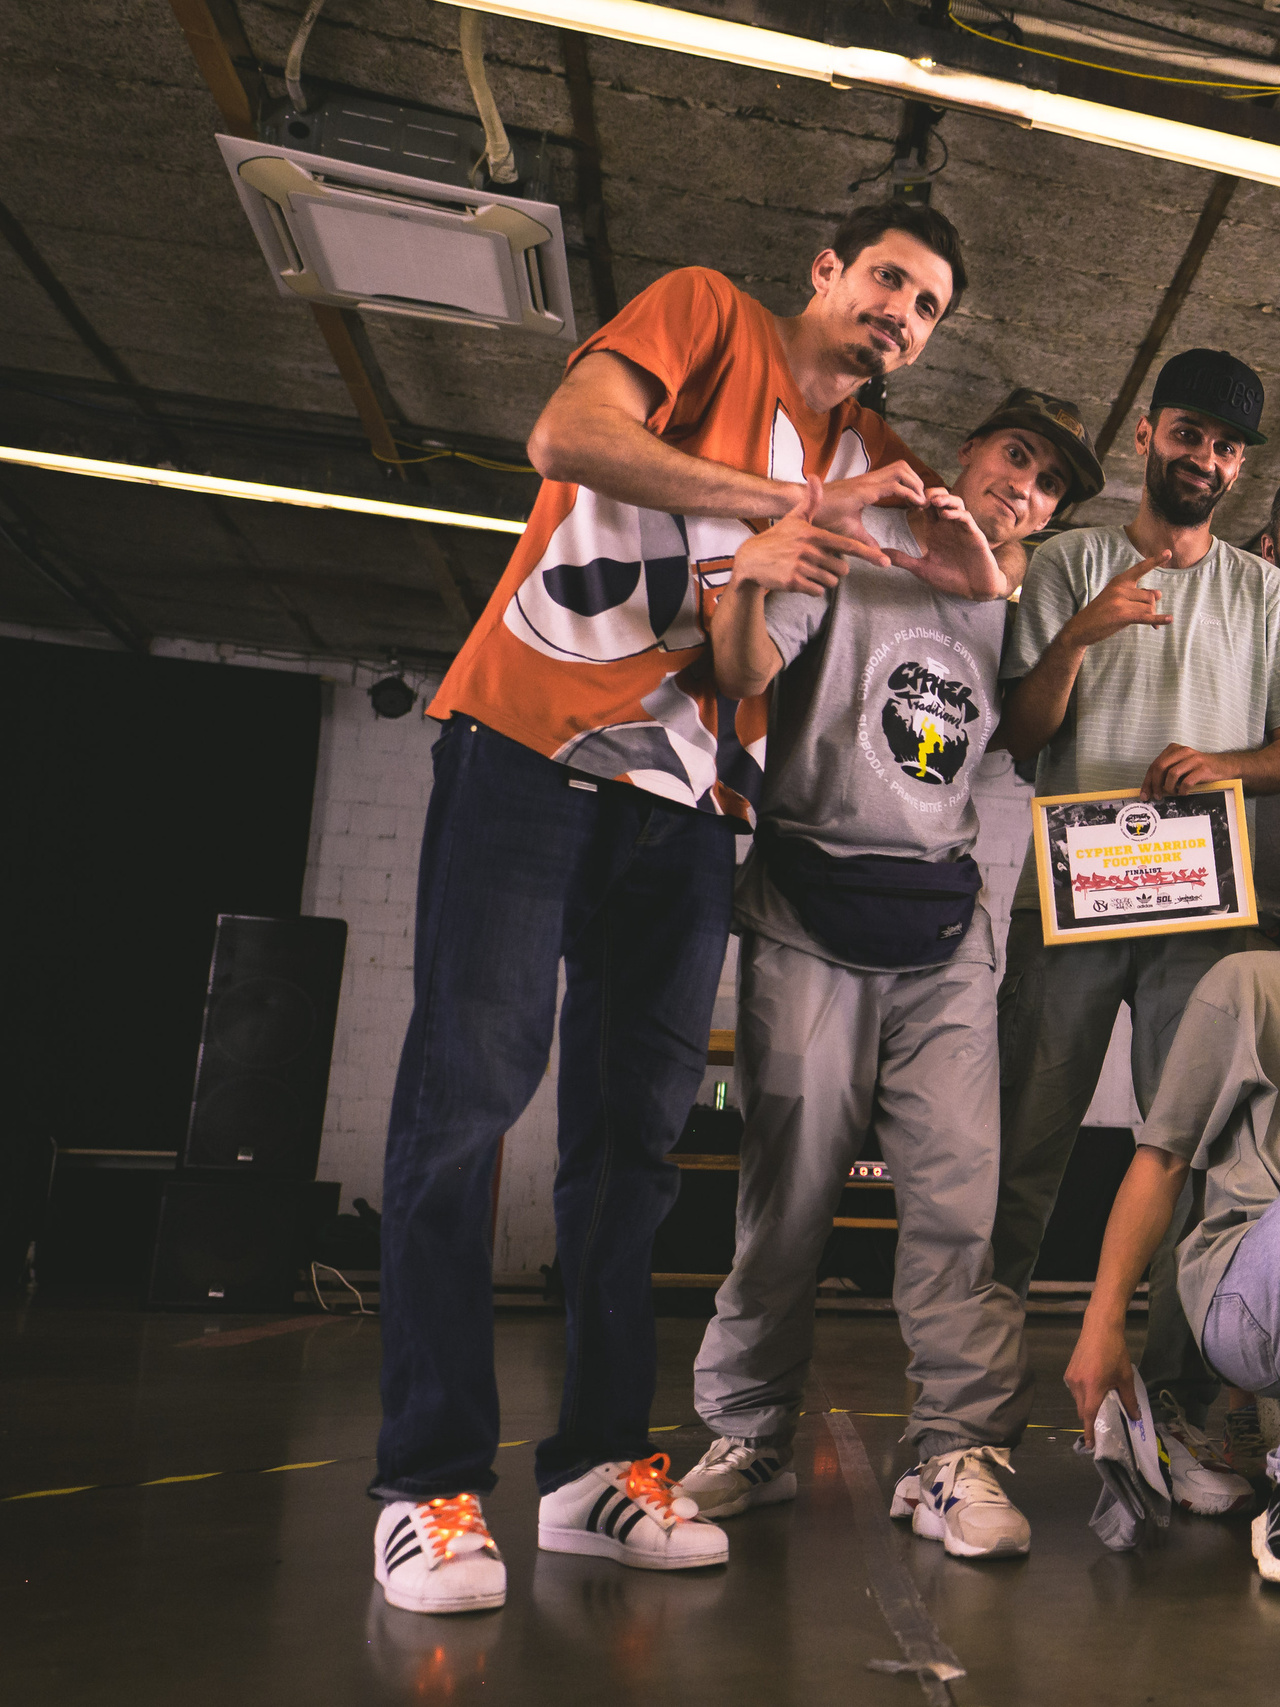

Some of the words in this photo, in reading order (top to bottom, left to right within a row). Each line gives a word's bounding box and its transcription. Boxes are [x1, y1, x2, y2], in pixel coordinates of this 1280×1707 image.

[1076, 845, 1133, 859] CYPHER
[1137, 838, 1207, 856] WARRIOR
[1102, 852, 1182, 868] FOOTWORK
[1125, 867, 1162, 876] FINALIST
